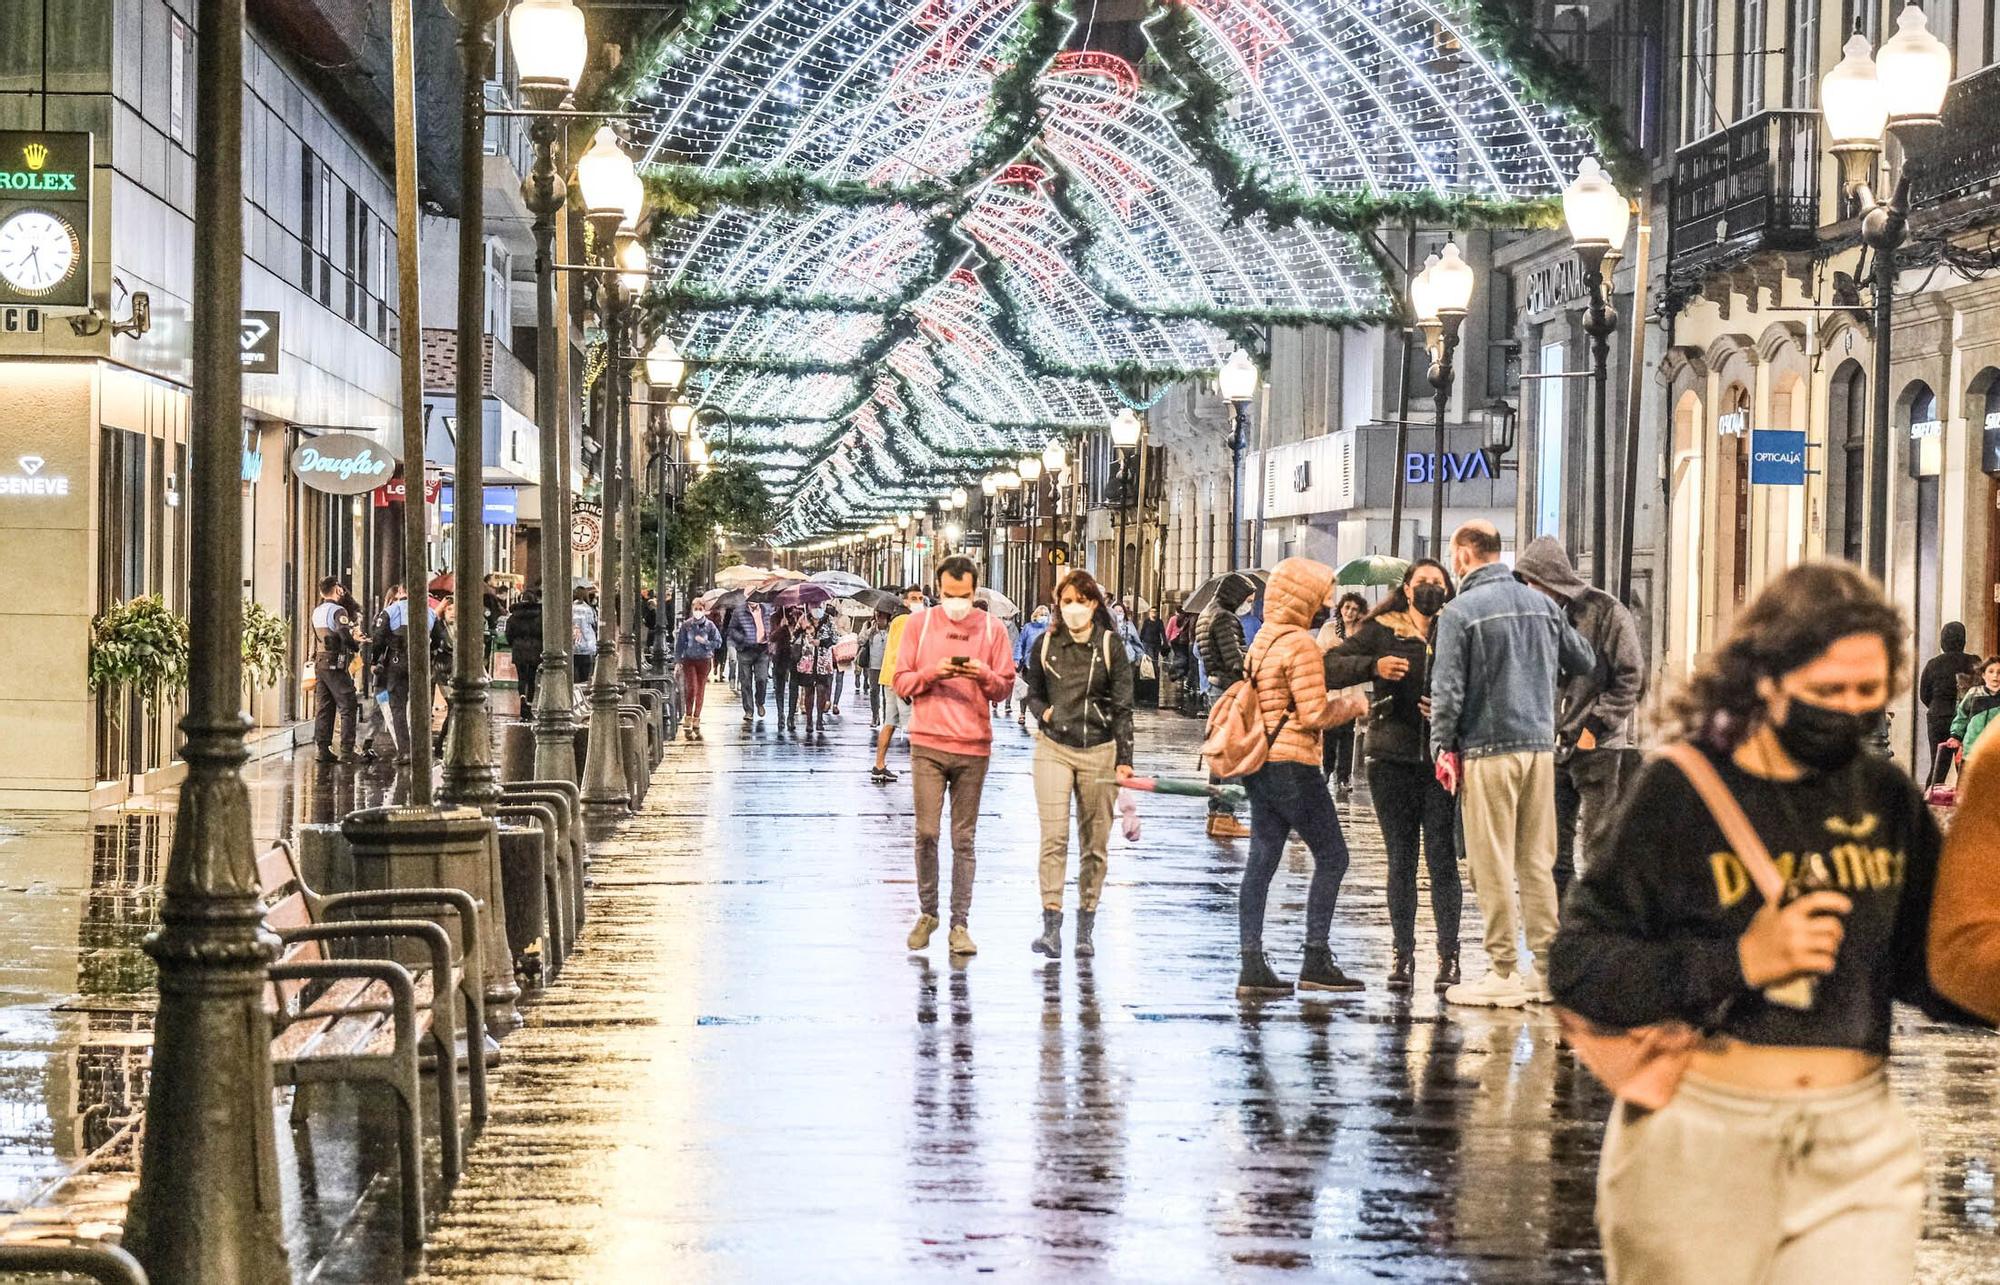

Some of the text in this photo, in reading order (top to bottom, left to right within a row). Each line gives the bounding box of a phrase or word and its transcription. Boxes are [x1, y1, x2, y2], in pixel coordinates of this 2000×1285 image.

[0, 172, 76, 190] ROLEX
[299, 448, 386, 481] Douglas
[1406, 448, 1489, 483] BBVA
[571, 501, 604, 517] ASINO
